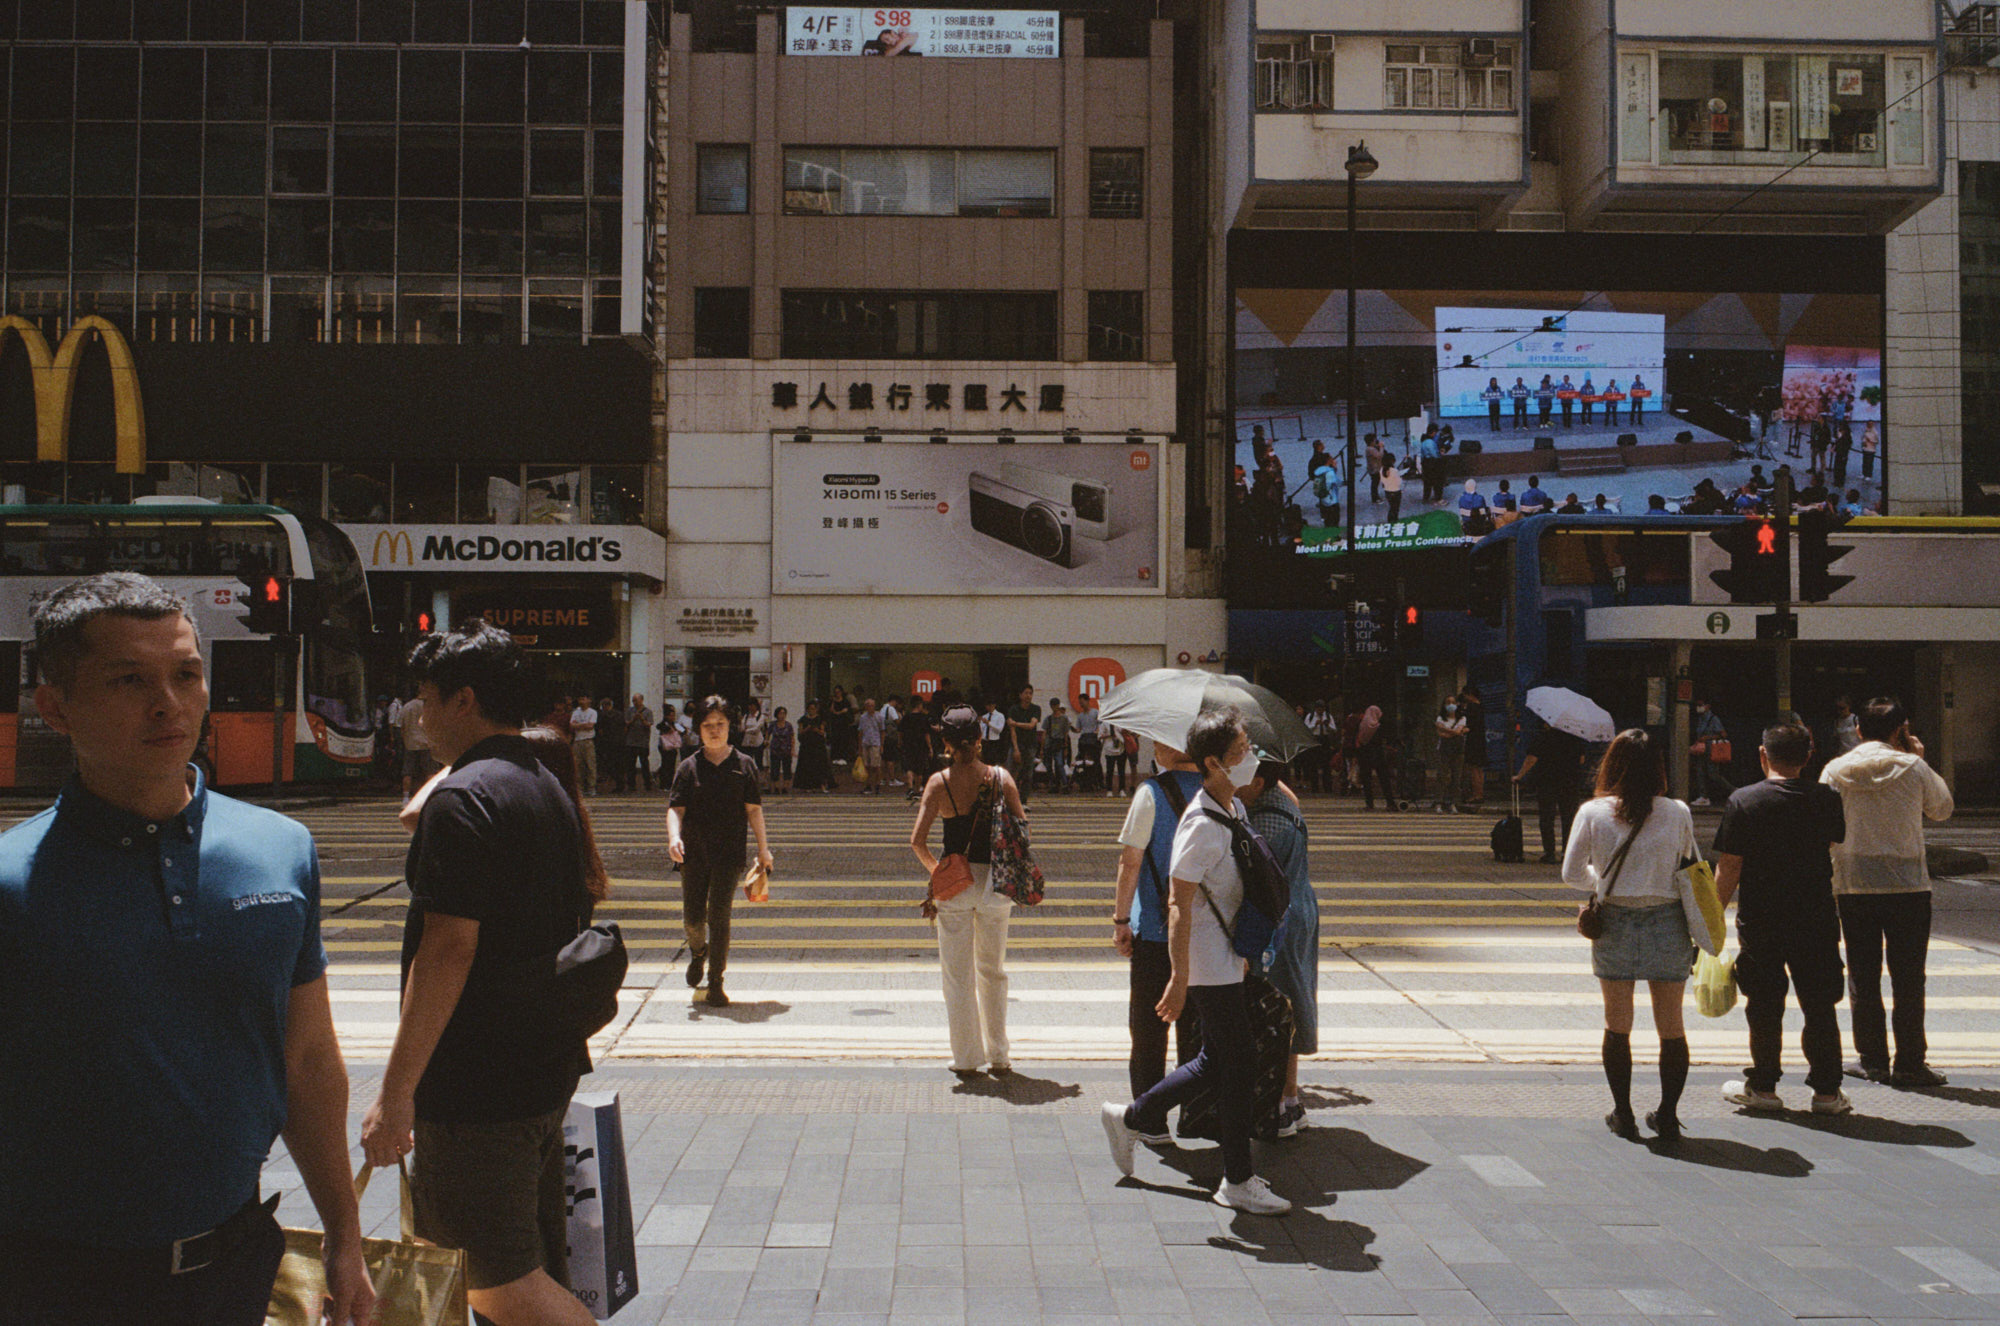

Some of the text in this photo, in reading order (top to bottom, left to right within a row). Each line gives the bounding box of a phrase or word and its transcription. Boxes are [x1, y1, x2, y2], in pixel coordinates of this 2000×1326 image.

[802, 15, 838, 35] 4/F
[874, 10, 911, 27] $98
[929, 30, 936, 40] 2
[929, 44, 936, 54] 3
[884, 489, 897, 500] 15
[900, 489, 936, 500] Series
[421, 535, 622, 563] McDonald's
[1295, 544, 1320, 554] Meet
[1322, 543, 1339, 553] the
[1384, 538, 1412, 549] Press
[1415, 536, 1472, 546] Conference
[483, 608, 590, 626] SUPREME
